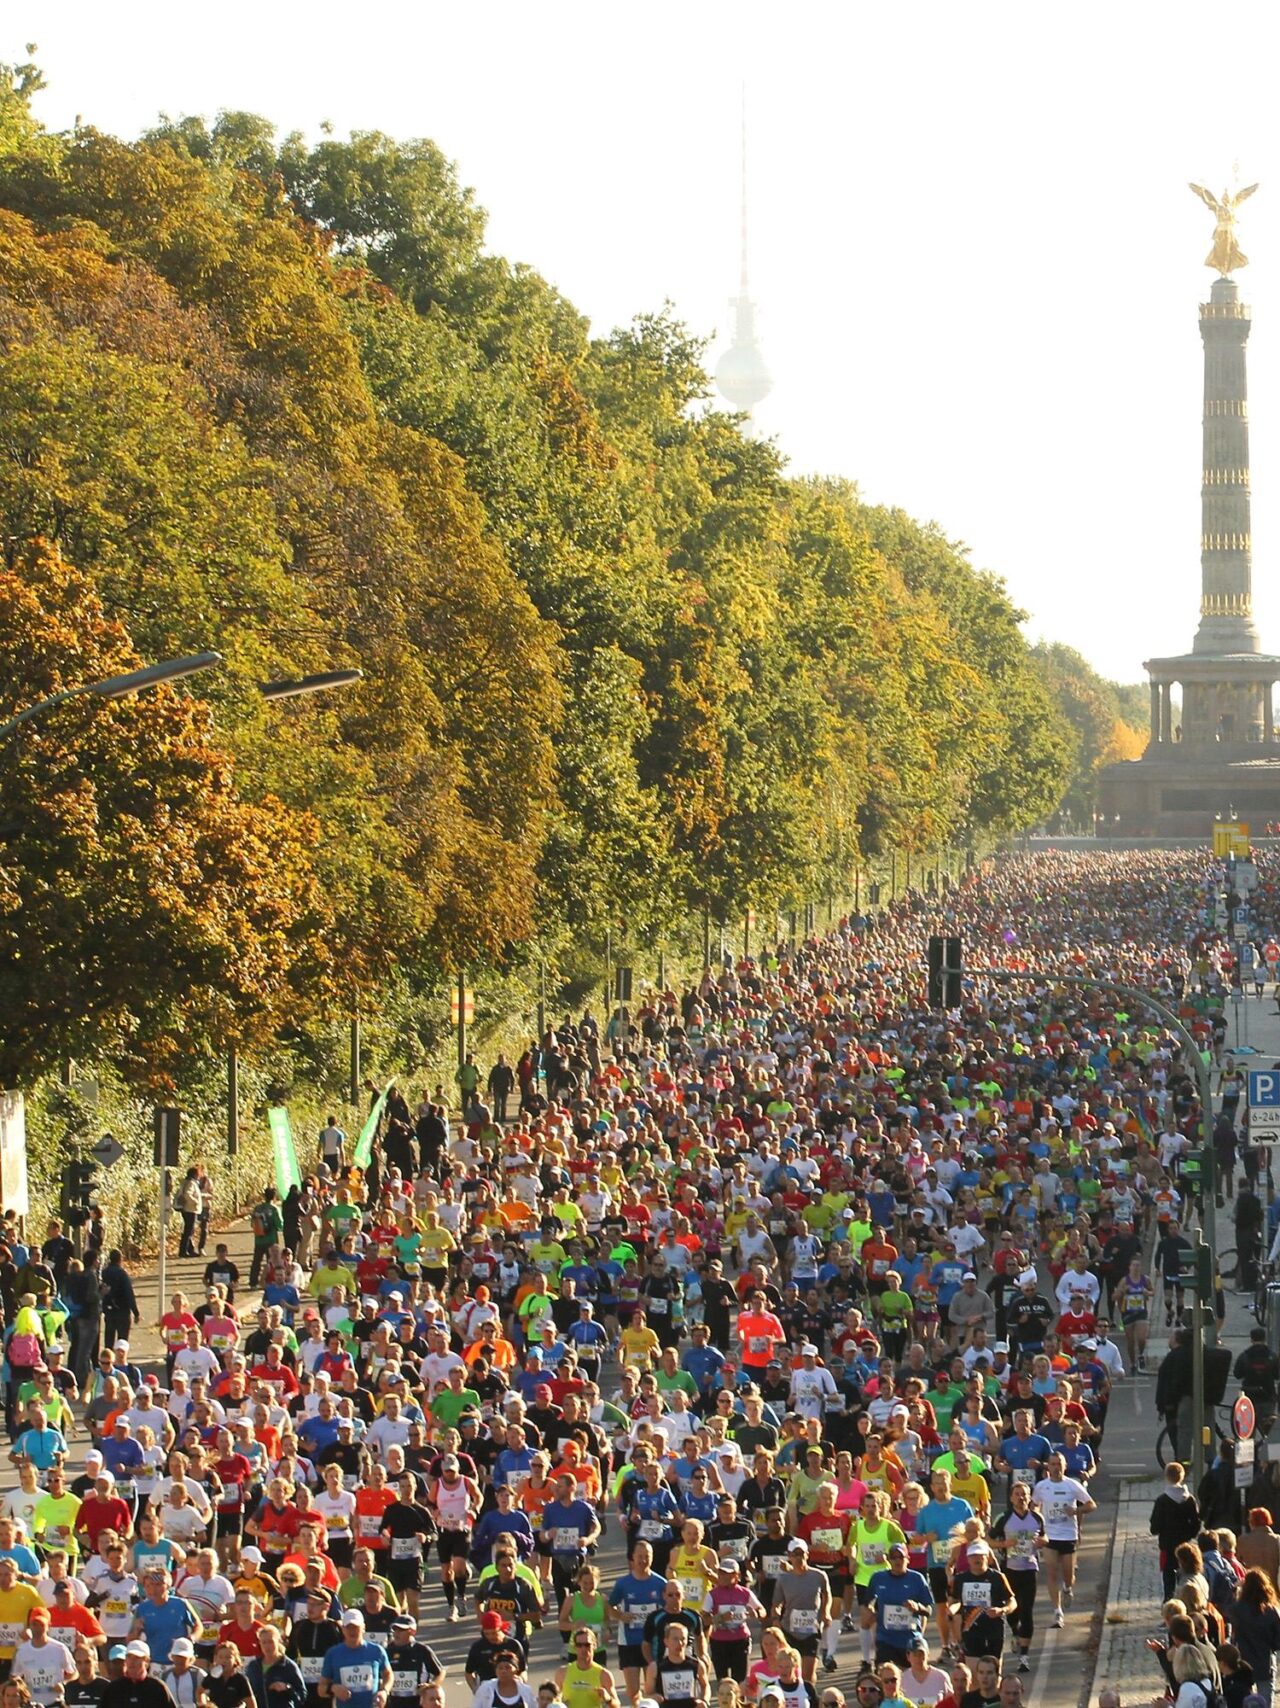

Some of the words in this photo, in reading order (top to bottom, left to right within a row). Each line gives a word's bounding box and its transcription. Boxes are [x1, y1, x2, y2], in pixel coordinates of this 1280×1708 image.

[1256, 1075, 1275, 1103] P
[1251, 1111, 1280, 1123] 6-24h
[488, 1598, 516, 1611] NYPD
